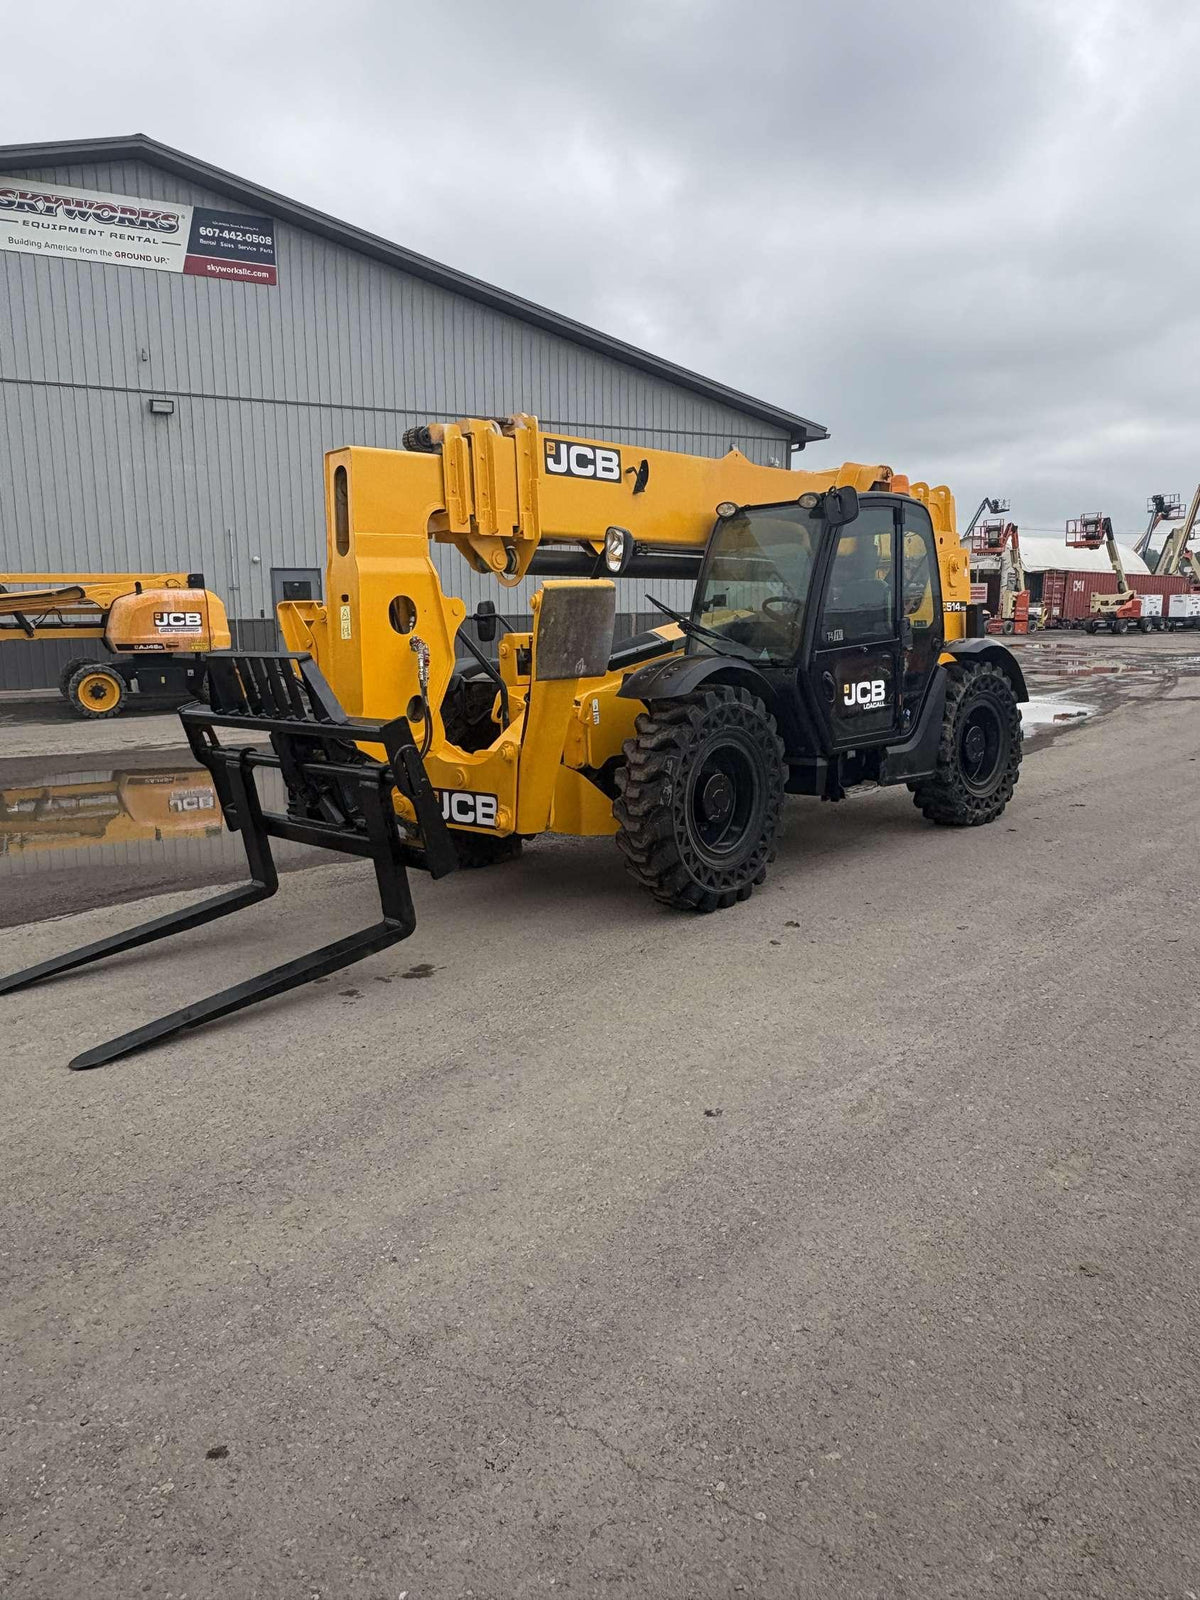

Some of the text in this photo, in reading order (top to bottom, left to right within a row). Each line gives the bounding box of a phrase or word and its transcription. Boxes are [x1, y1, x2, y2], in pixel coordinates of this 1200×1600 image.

[0, 187, 179, 234] SKYWORKS
[22, 220, 159, 244] EQUIPMENT RENTAL
[199, 226, 272, 245] 607-442-0508
[8, 236, 42, 249] Building
[44, 241, 78, 253] America
[79, 246, 98, 256] from
[99, 248, 113, 257] the
[114, 250, 152, 262] GROUND
[206, 264, 269, 278] skyworksllc.com
[546, 443, 620, 480] JCB
[155, 612, 202, 626] JCB
[844, 680, 885, 706] JCB
